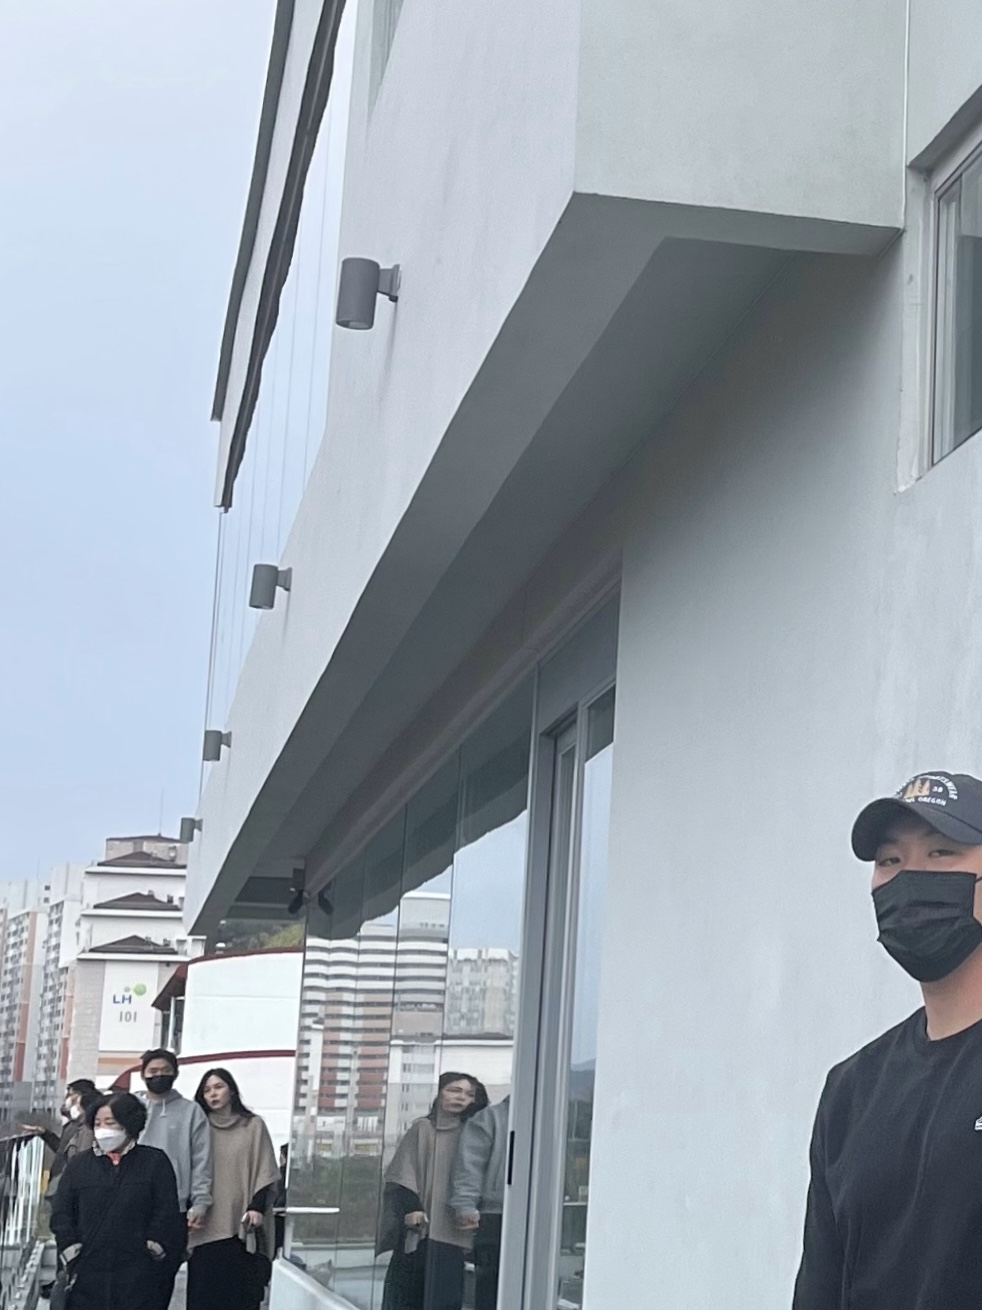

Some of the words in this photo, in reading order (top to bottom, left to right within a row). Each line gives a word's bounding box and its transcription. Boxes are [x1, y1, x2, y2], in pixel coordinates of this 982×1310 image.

[918, 797, 947, 806] OREGON
[113, 994, 132, 1004] LH
[119, 1011, 137, 1022] 101
